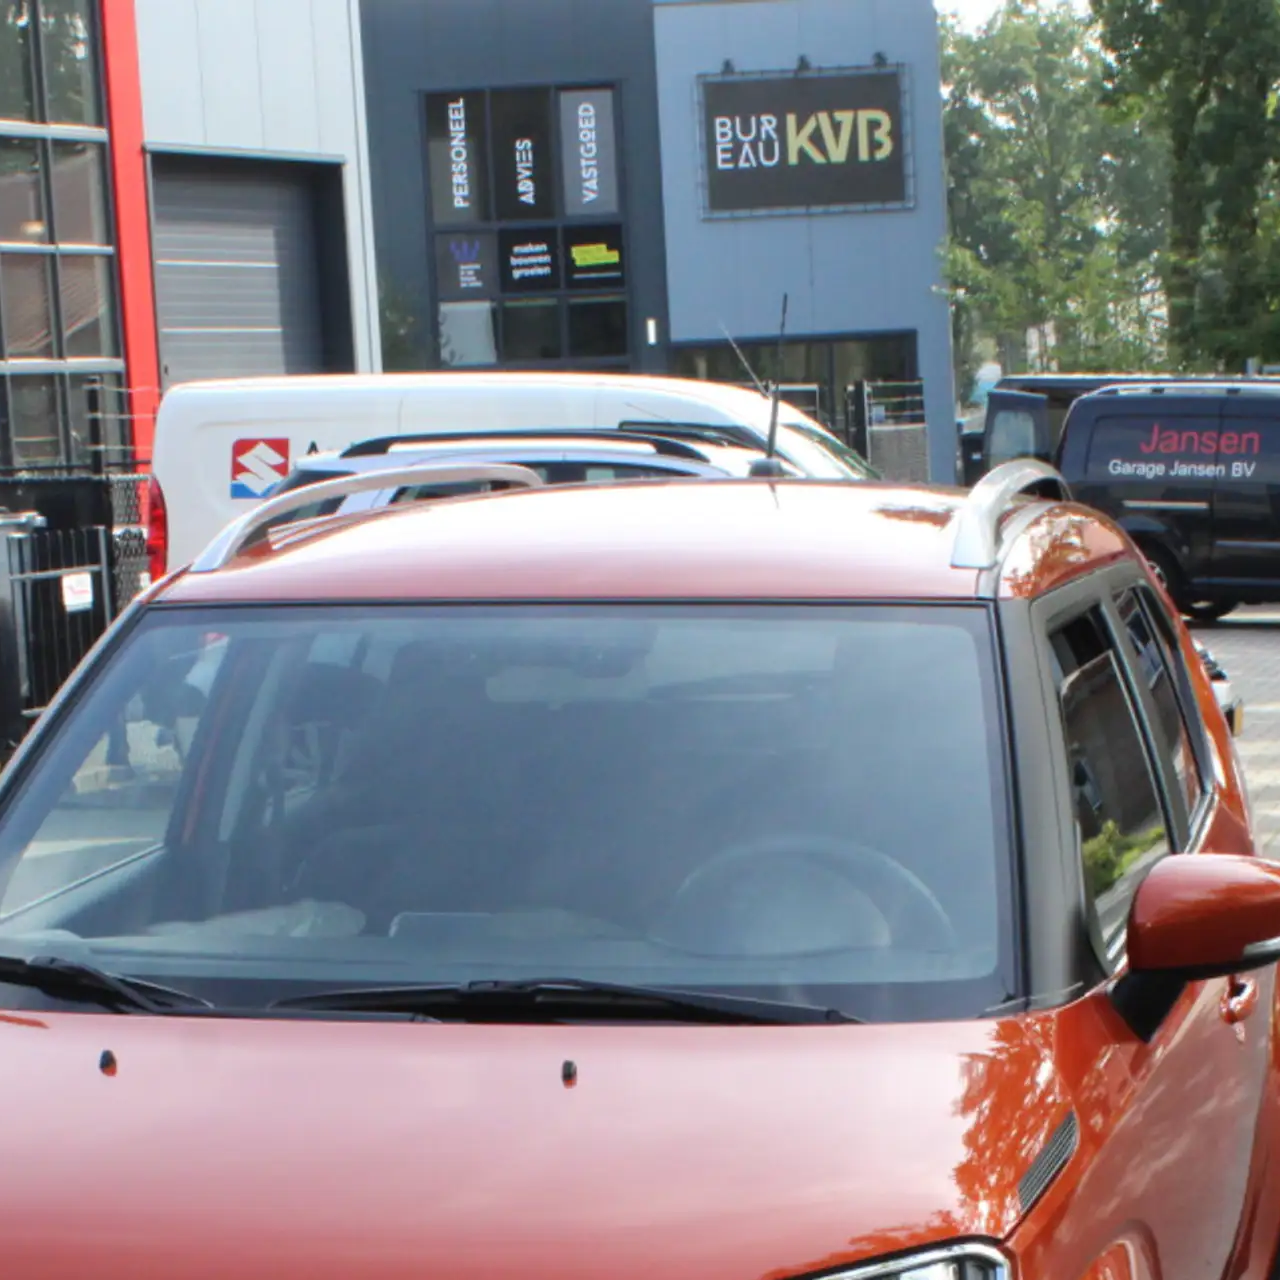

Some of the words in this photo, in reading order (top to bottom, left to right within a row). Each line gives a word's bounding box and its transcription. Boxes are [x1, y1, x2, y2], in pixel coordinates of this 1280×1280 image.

[714, 113, 778, 142] BUR
[785, 108, 894, 166] KVB
[448, 96, 470, 208] PERSONEEL
[515, 137, 535, 205] ADVIES
[578, 102, 599, 205] VASTGOED
[715, 140, 780, 170] EAU
[1139, 423, 1262, 454] Jansen
[1108, 459, 1166, 479] Garage
[1169, 460, 1226, 478] Jansen
[1231, 461, 1256, 478] BV
